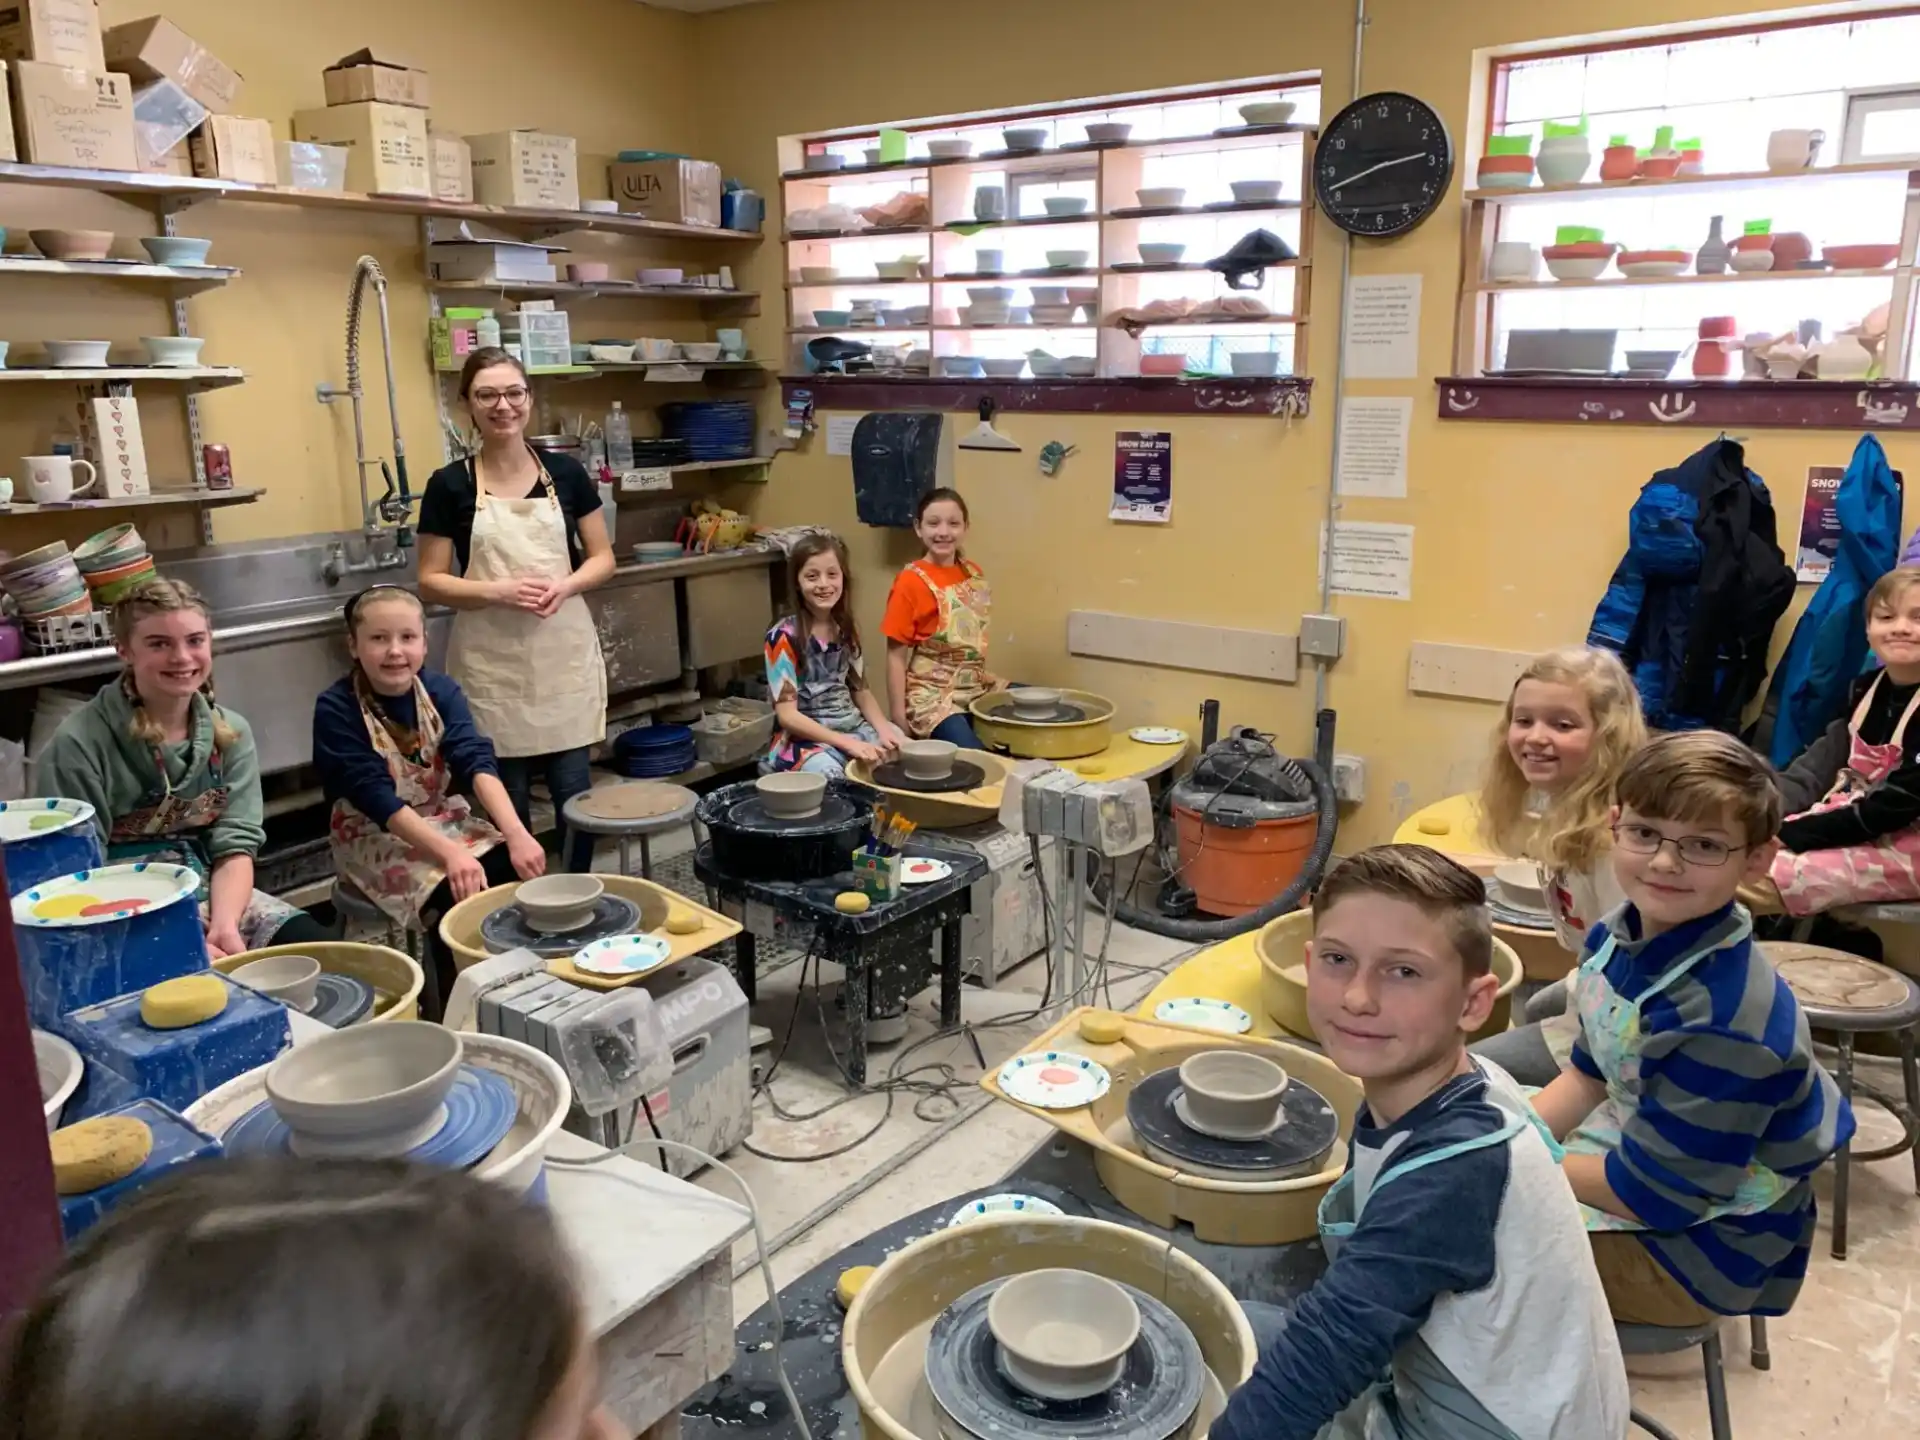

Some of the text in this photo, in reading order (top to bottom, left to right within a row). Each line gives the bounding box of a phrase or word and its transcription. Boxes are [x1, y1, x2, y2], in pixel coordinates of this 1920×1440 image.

[1377, 107, 1389, 118] 12
[1406, 112, 1412, 123] 1
[1352, 118, 1362, 131] 11
[1422, 128, 1429, 140] 2
[1335, 139, 1346, 150] 10
[1428, 155, 1436, 166] 3
[1328, 166, 1336, 177] 9
[626, 174, 662, 193] ULTA
[1422, 182, 1429, 193] 4
[1335, 191, 1342, 202] 8
[1353, 209, 1359, 219] 7
[1402, 204, 1409, 215] 5
[1376, 214, 1384, 225] 6
[1117, 440, 1139, 448] SNOW
[1140, 441, 1154, 449] DAY
